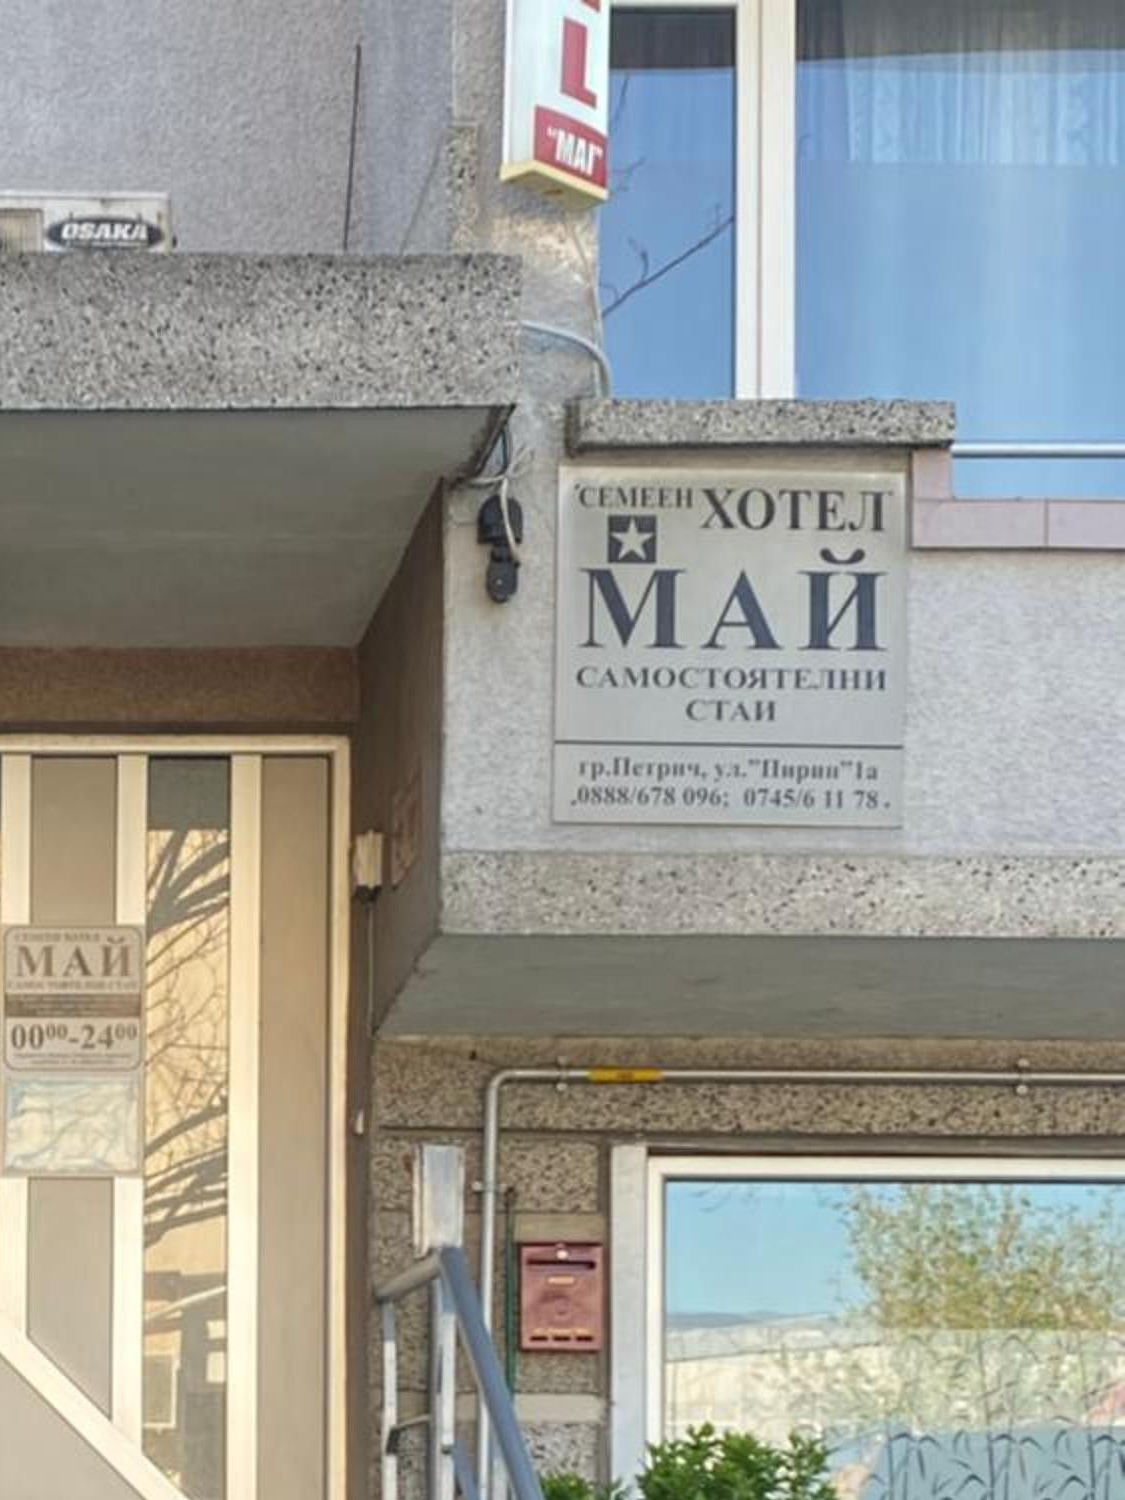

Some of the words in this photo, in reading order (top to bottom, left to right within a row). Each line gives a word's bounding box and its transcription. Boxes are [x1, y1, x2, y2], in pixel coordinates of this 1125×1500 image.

[61, 222, 147, 240] OSAKA
[579, 486, 692, 508] СЕМЕЕН
[699, 487, 888, 532] ХОТЕЛ
[579, 548, 888, 651] МАЙ
[576, 666, 886, 690] САМОСТОЯТЕЛНИ
[685, 699, 776, 722] СТАИ
[17, 936, 131, 977] МАЙ
